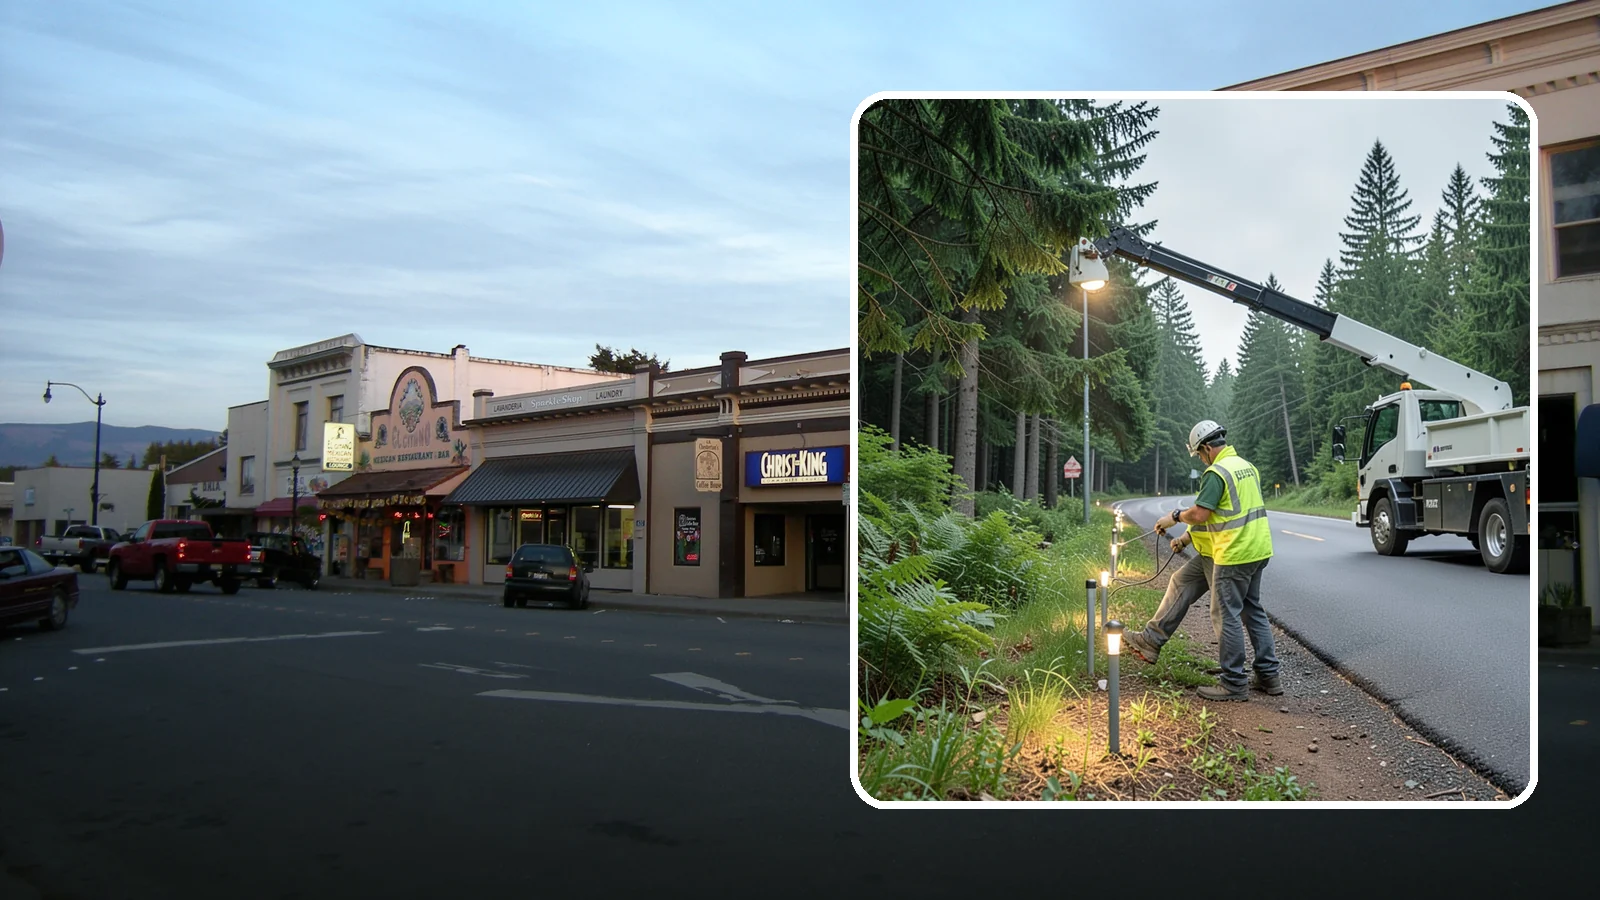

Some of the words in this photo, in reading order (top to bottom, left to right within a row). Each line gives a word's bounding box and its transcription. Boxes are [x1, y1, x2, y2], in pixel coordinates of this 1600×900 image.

[530, 396, 561, 409] Sparkle
[562, 394, 582, 405] Shop
[595, 389, 624, 400] LAUNDRY
[493, 402, 522, 413] LAVANDERIA
[391, 425, 401, 449] EL
[373, 454, 397, 464] MEXICAN
[397, 451, 433, 462] RESTAURANT
[437, 450, 450, 459] BAR
[761, 452, 798, 478] CHRIST
[799, 450, 827, 476] KING
